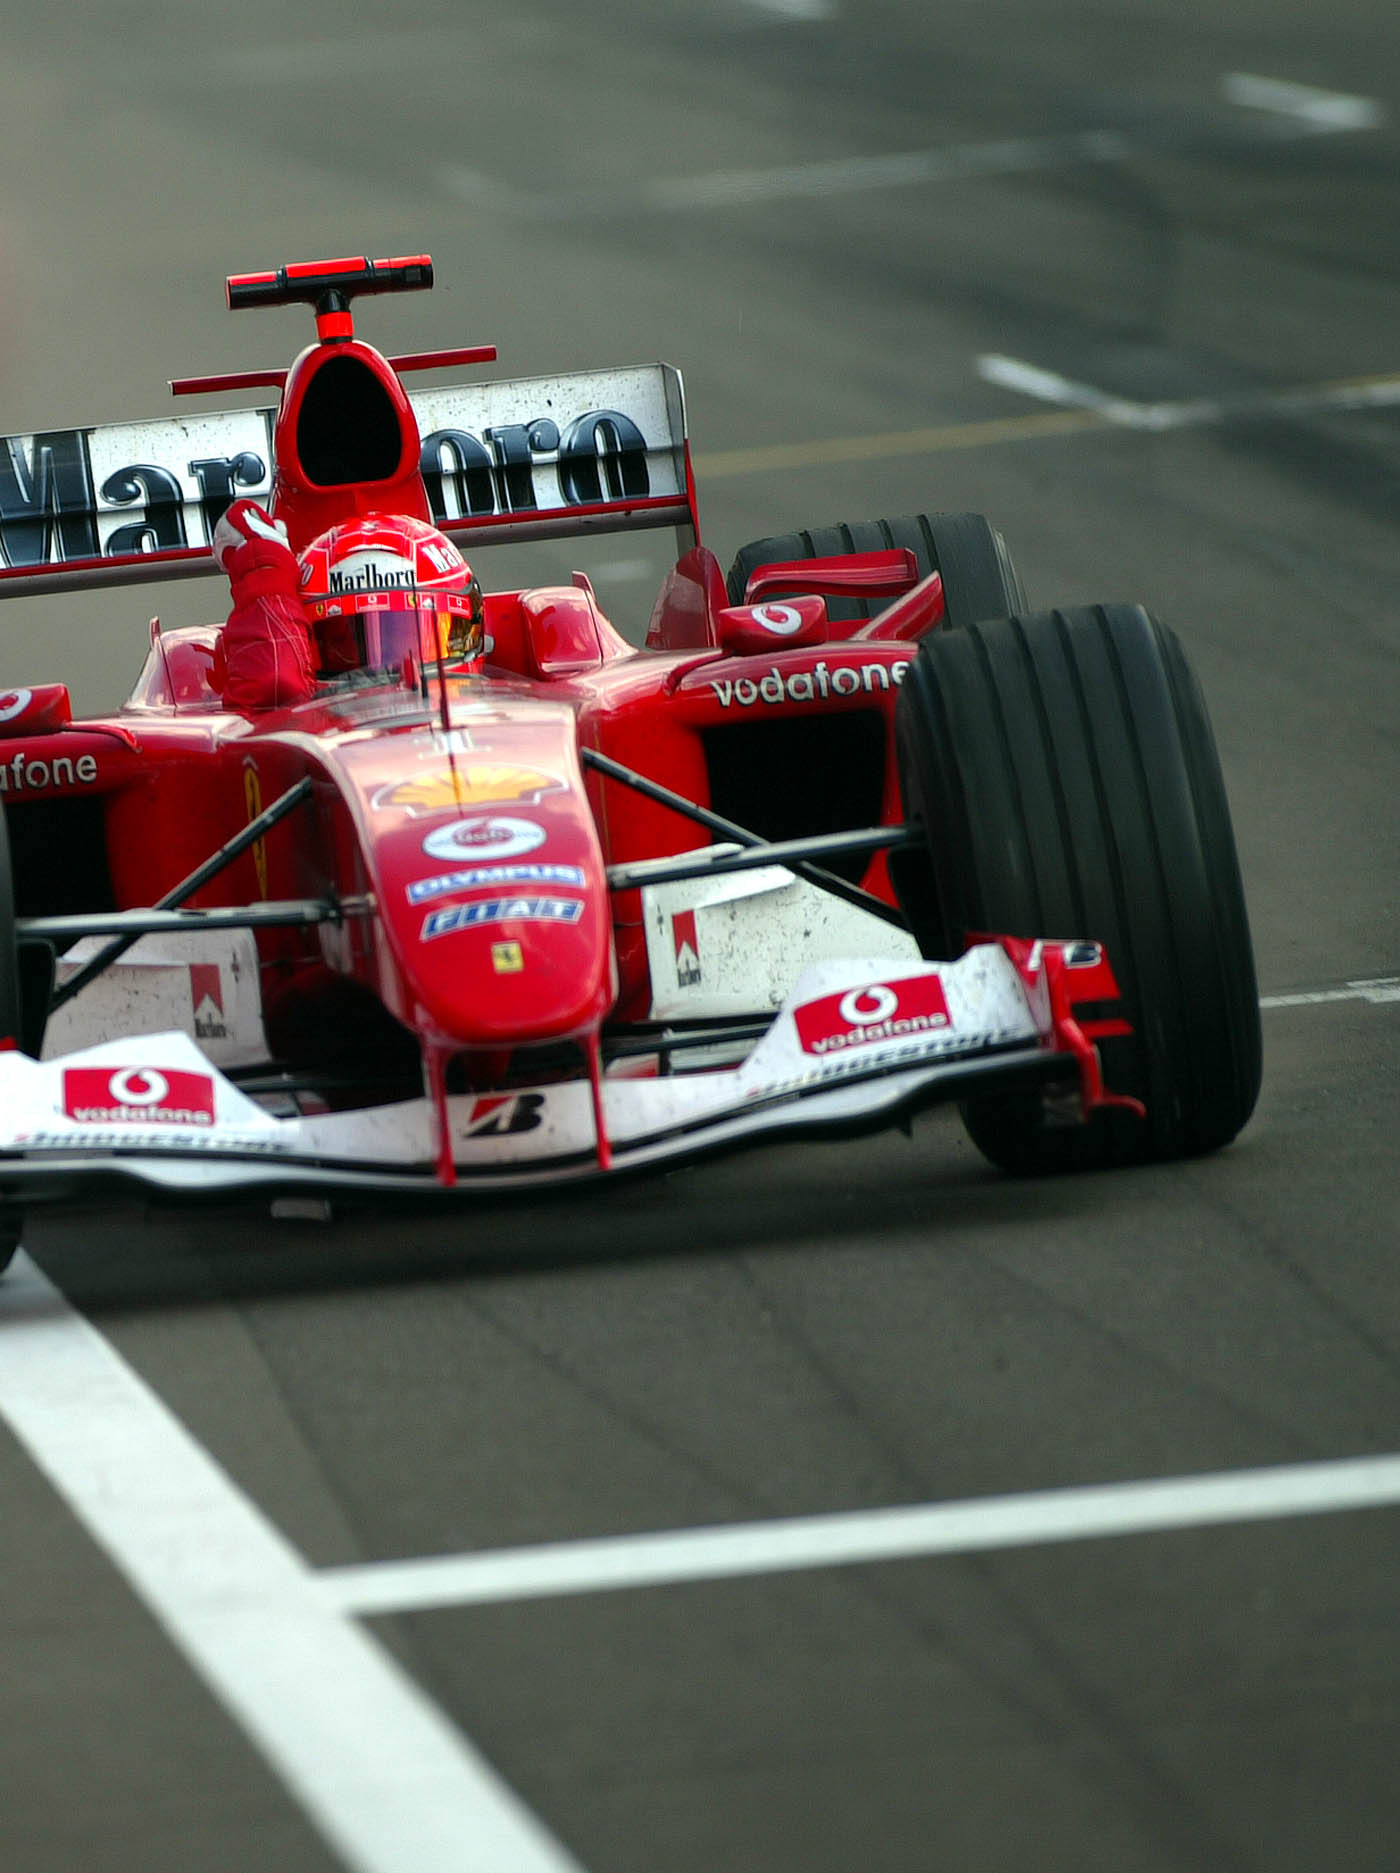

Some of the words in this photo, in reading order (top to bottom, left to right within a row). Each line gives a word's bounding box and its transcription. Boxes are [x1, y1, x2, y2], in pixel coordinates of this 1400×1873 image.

[710, 661, 910, 707] vodafone
[412, 867, 581, 901] OLYMPUS
[434, 901, 578, 930] FIAT
[811, 1011, 947, 1053] vodafone
[73, 1106, 210, 1124] vodafone
